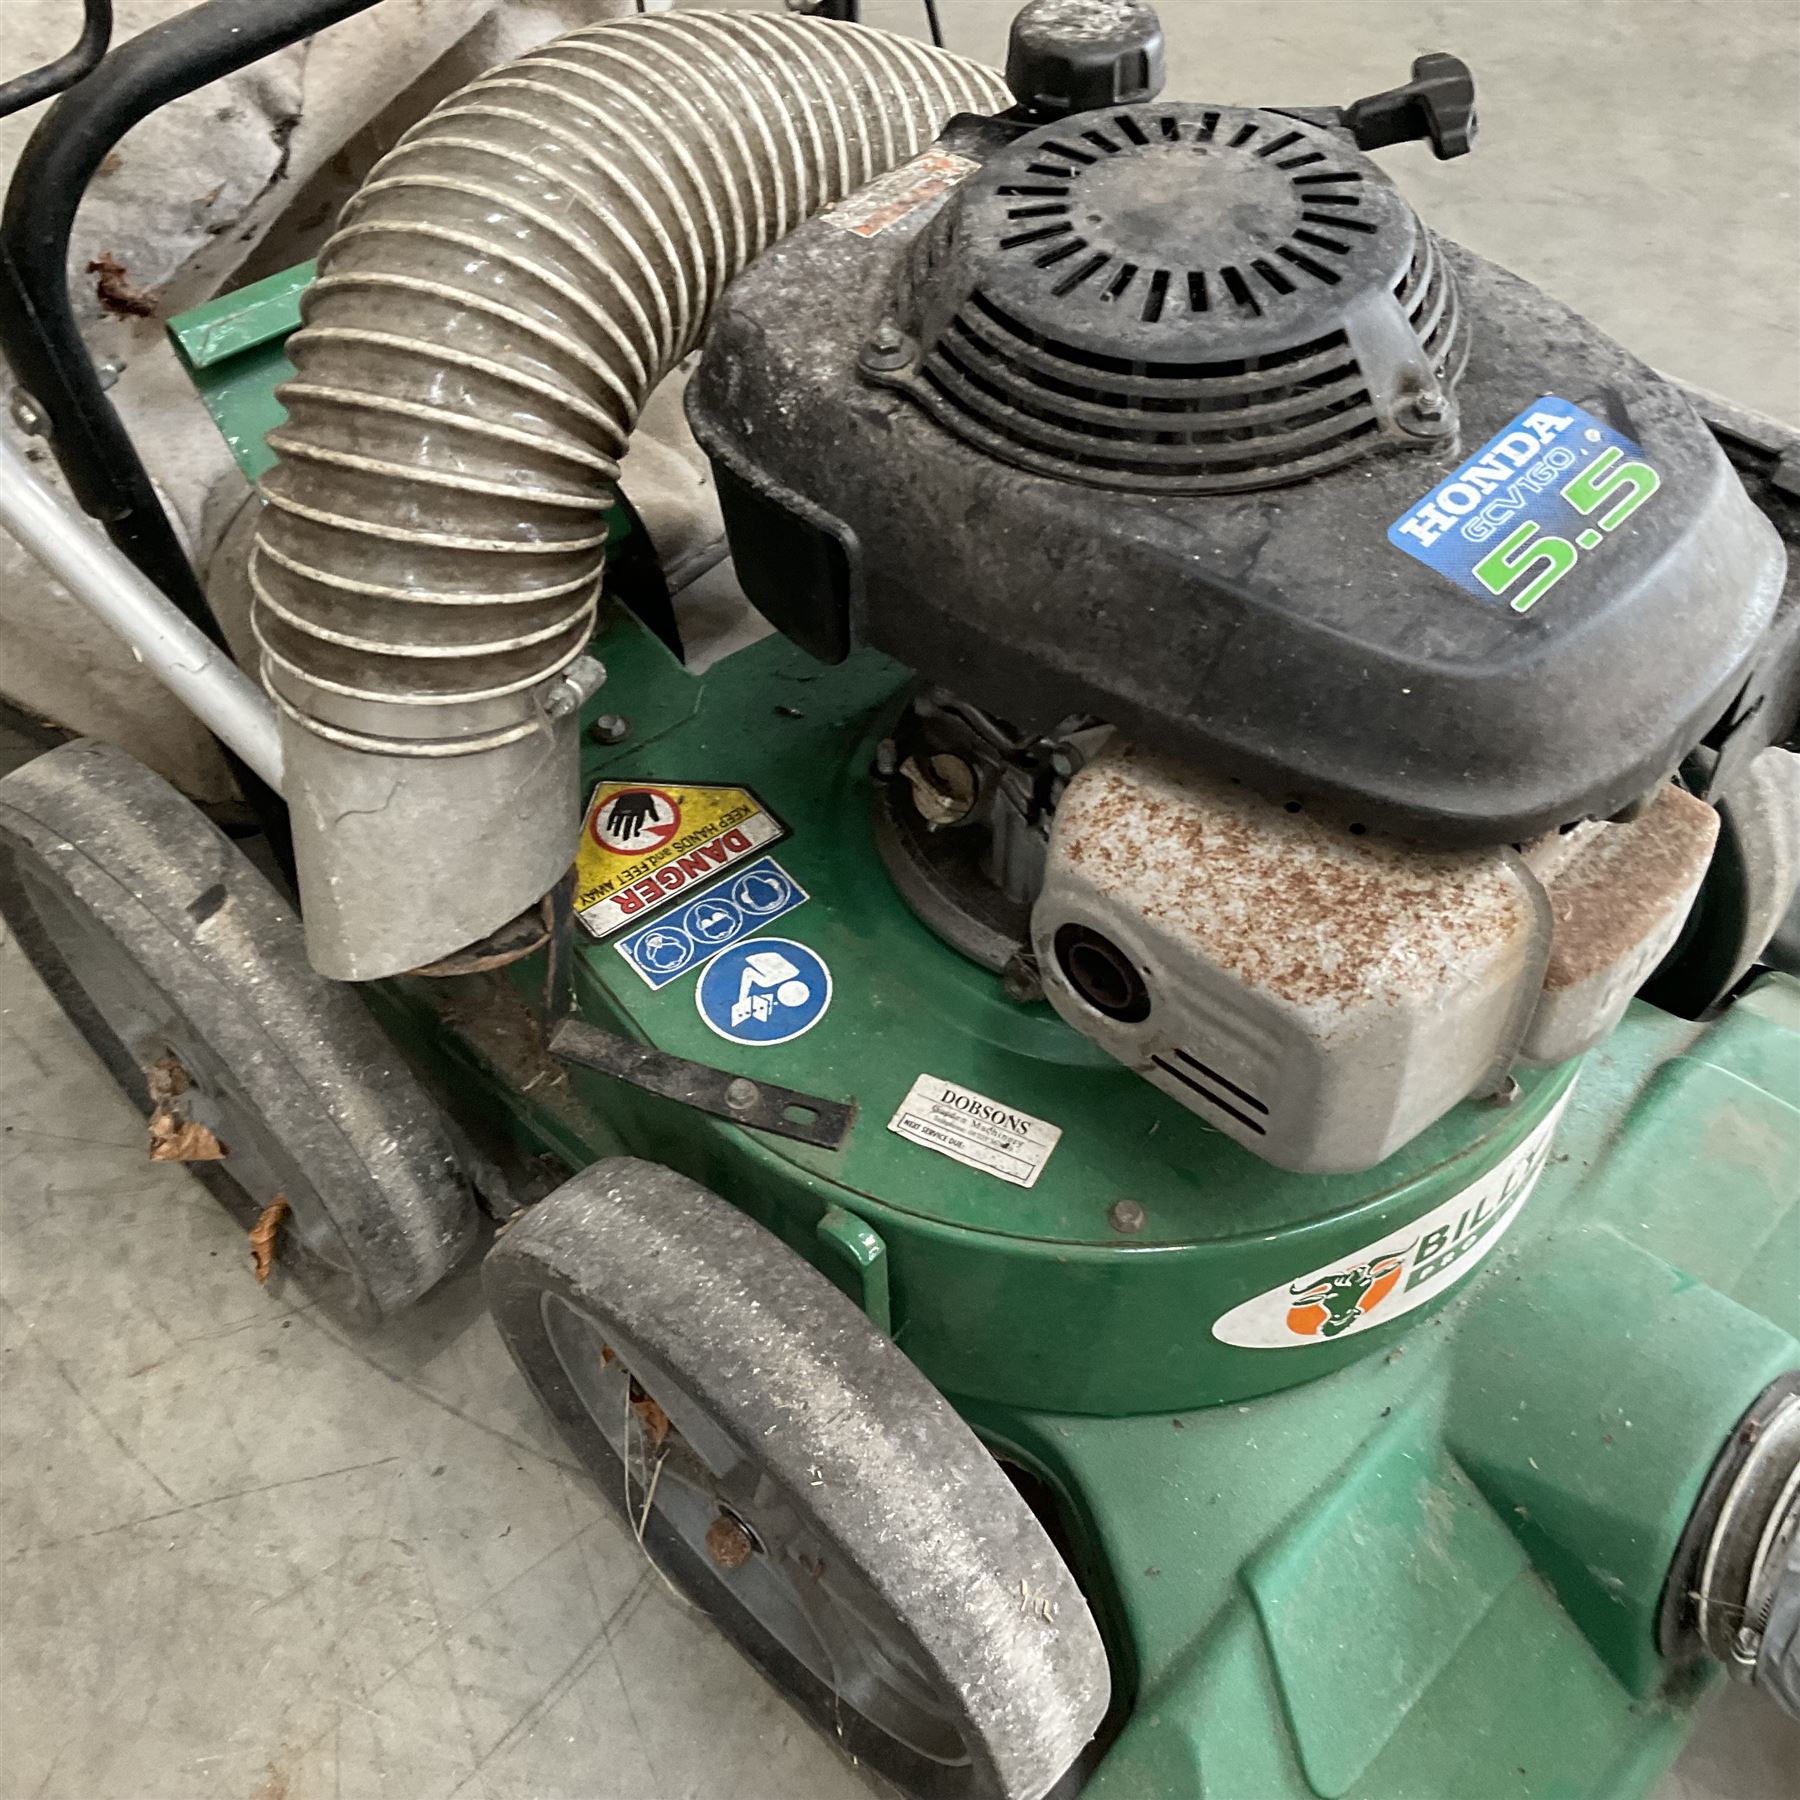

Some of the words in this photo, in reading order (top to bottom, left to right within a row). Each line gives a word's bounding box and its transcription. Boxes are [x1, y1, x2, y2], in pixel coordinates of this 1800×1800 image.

[1398, 411, 1575, 548] HONDA
[1460, 446, 1577, 543] GCV160
[1471, 446, 1661, 613] 5.5
[719, 804, 752, 829] KEEP
[672, 822, 718, 853] HANDS
[610, 828, 752, 914] DANGER
[650, 849, 673, 866] and
[616, 863, 650, 885] FEET
[579, 880, 614, 906] AWAY
[941, 1090, 1032, 1135] DOBSONS
[903, 1118, 919, 1130] NEXT
[921, 1124, 948, 1142] SERVICE
